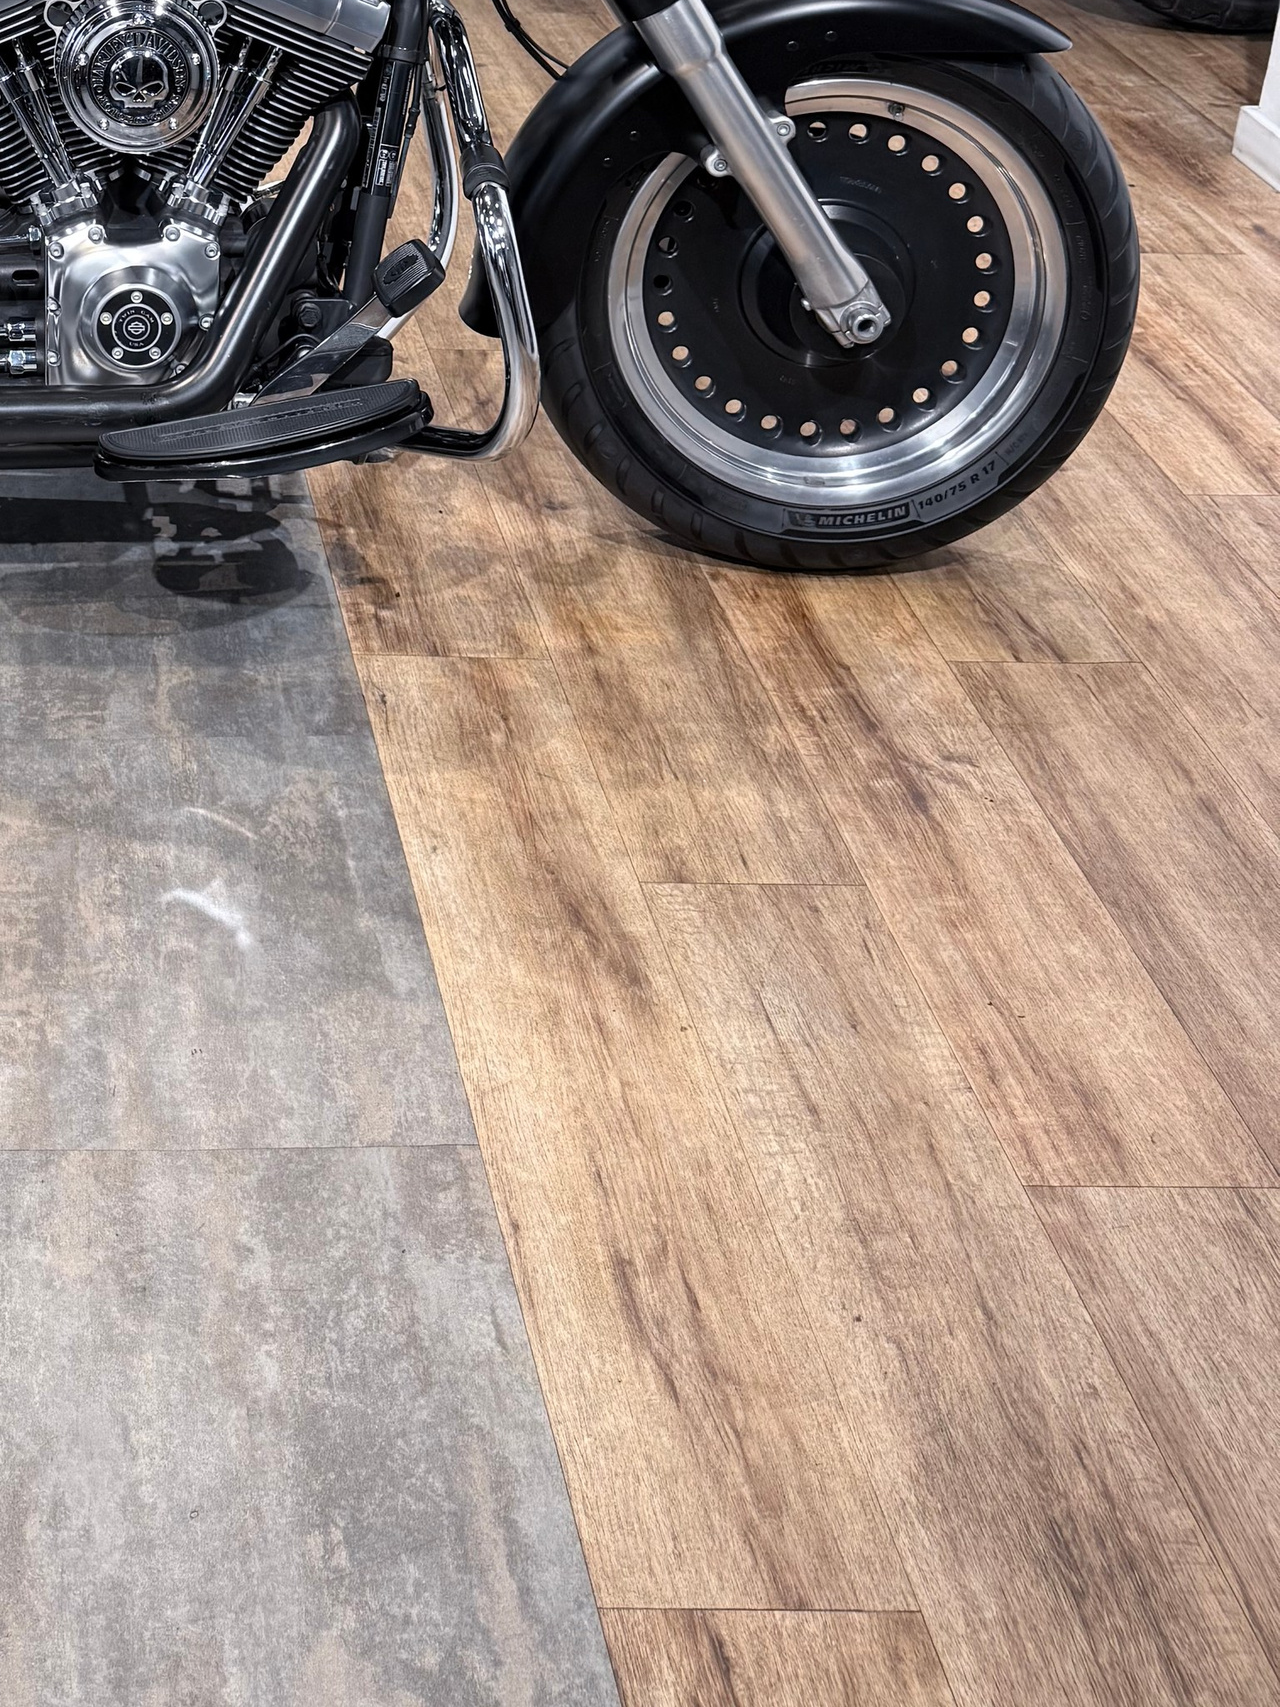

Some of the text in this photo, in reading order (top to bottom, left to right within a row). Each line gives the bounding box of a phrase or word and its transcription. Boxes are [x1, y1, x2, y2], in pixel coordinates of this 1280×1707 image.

[118, 309, 155, 324] TWIN CAM
[817, 505, 907, 527] MICHELIN
[917, 481, 968, 511] 140/75
[970, 473, 981, 485] R
[981, 460, 998, 476] 17
